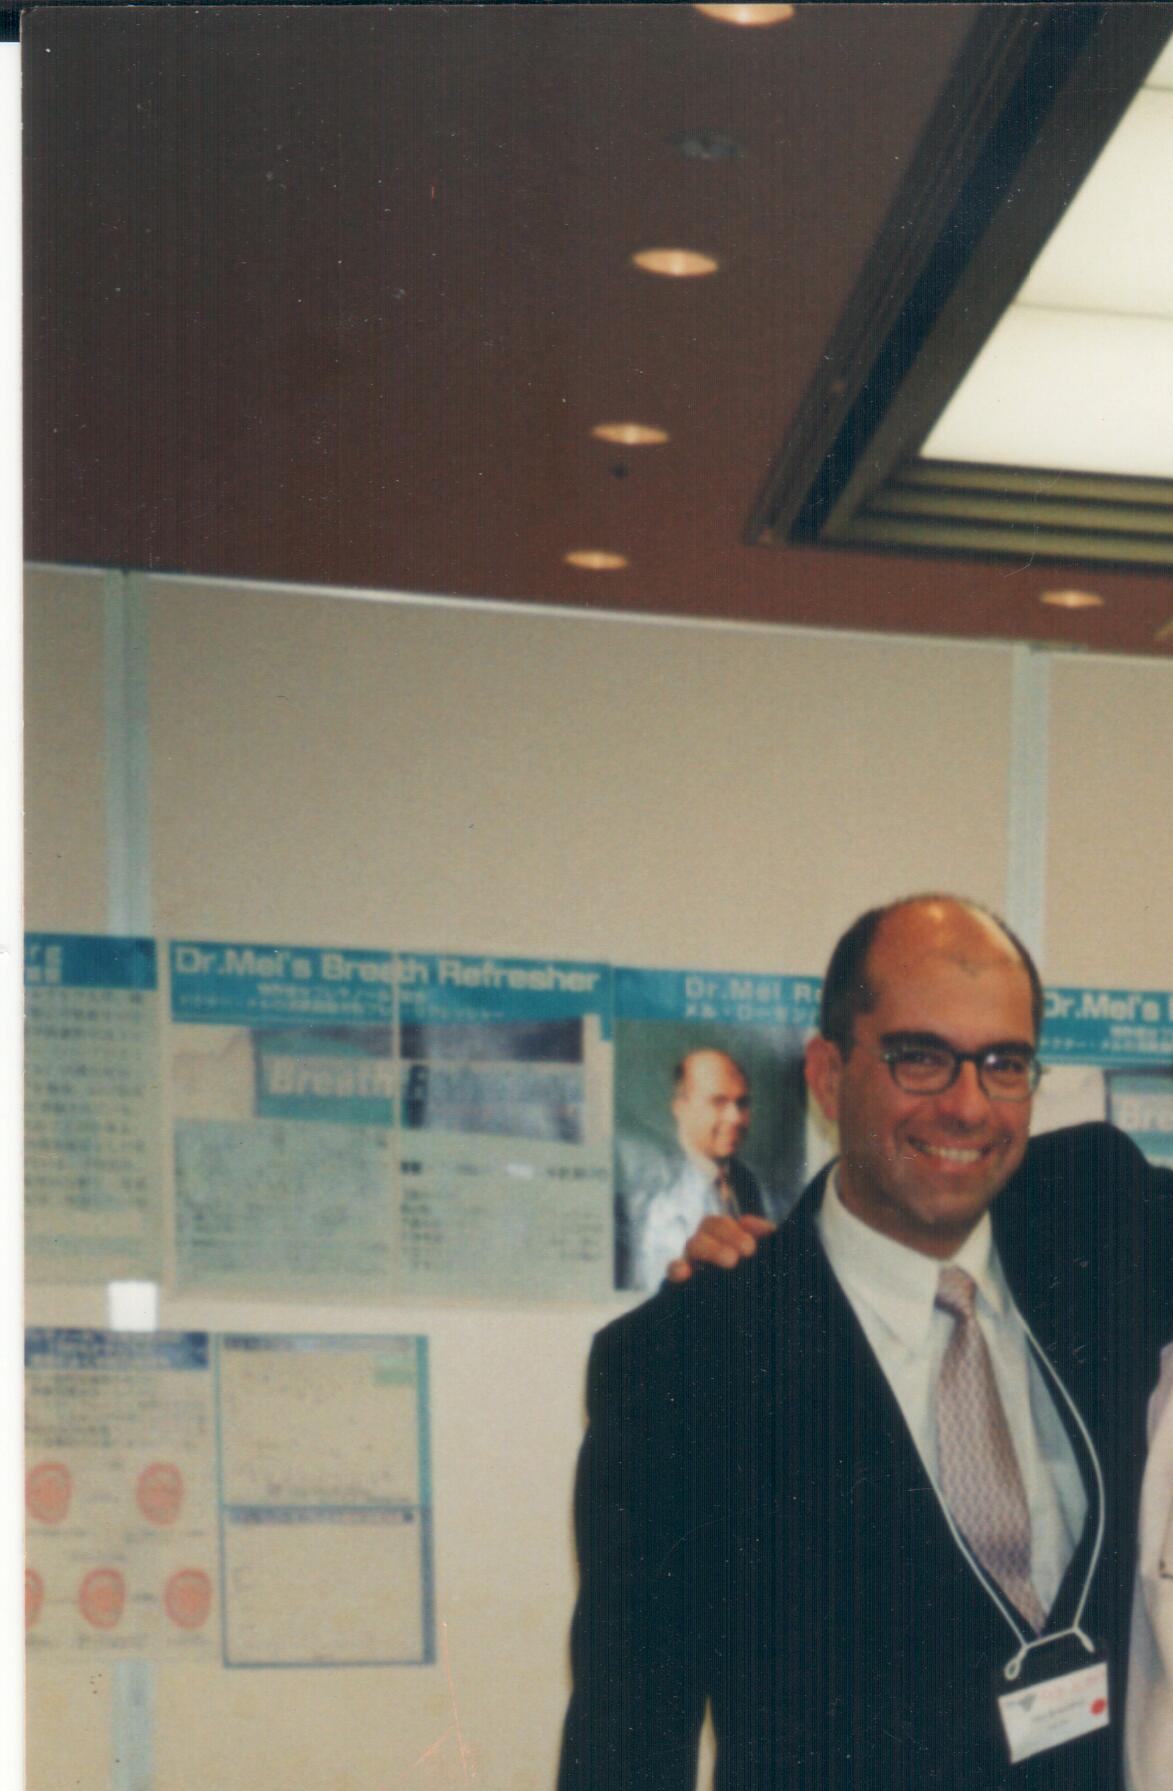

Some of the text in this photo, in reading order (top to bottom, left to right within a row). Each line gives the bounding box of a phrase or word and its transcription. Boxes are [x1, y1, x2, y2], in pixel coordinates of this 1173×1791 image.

[175, 946, 600, 992] Dr.Mel's Breath Refresher
